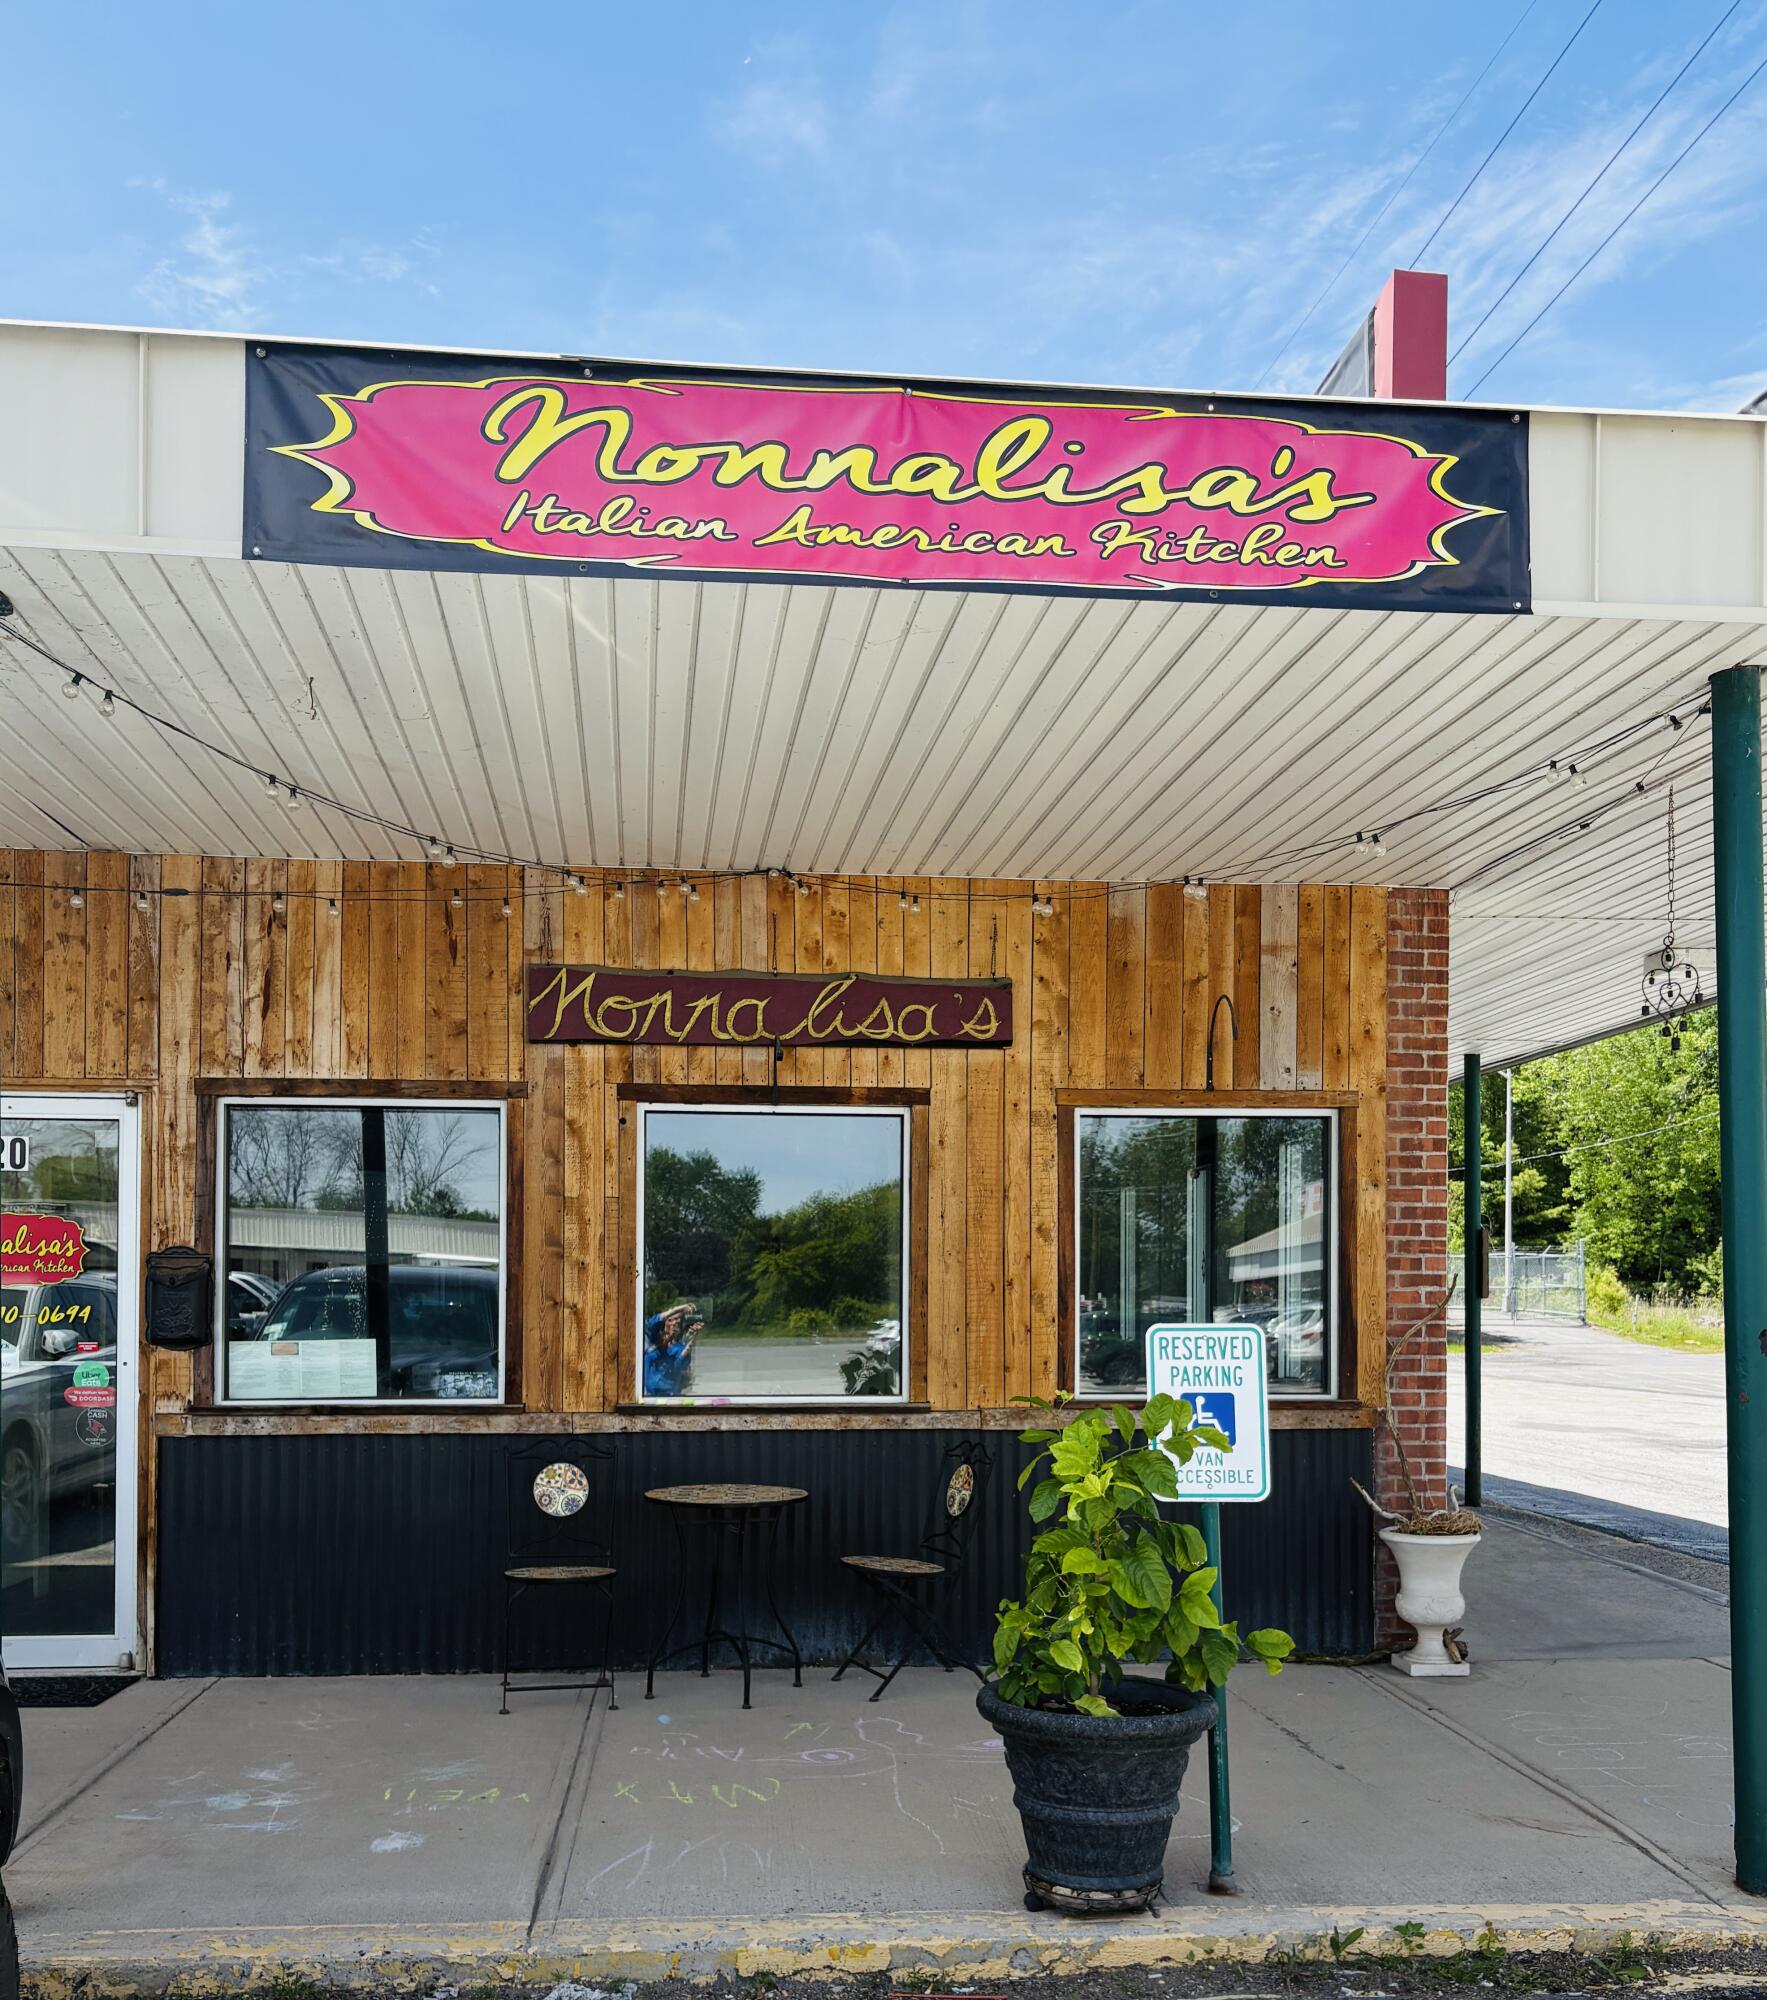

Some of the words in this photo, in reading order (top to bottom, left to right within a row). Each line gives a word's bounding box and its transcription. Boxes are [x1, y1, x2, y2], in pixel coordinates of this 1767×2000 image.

[482, 384, 1377, 522] Nonnalisa's
[502, 490, 739, 541] Italian
[753, 504, 1077, 558] American
[1091, 520, 1348, 569] Kitchen
[0, 1137, 26, 1169] 0
[32, 1258, 75, 1274] Kitchen
[1159, 1336, 1253, 1361] RESERVED
[1170, 1365, 1243, 1387] PARKING
[1196, 1452, 1224, 1467] VAN
[1176, 1470, 1254, 1484] CCESSIBLE
